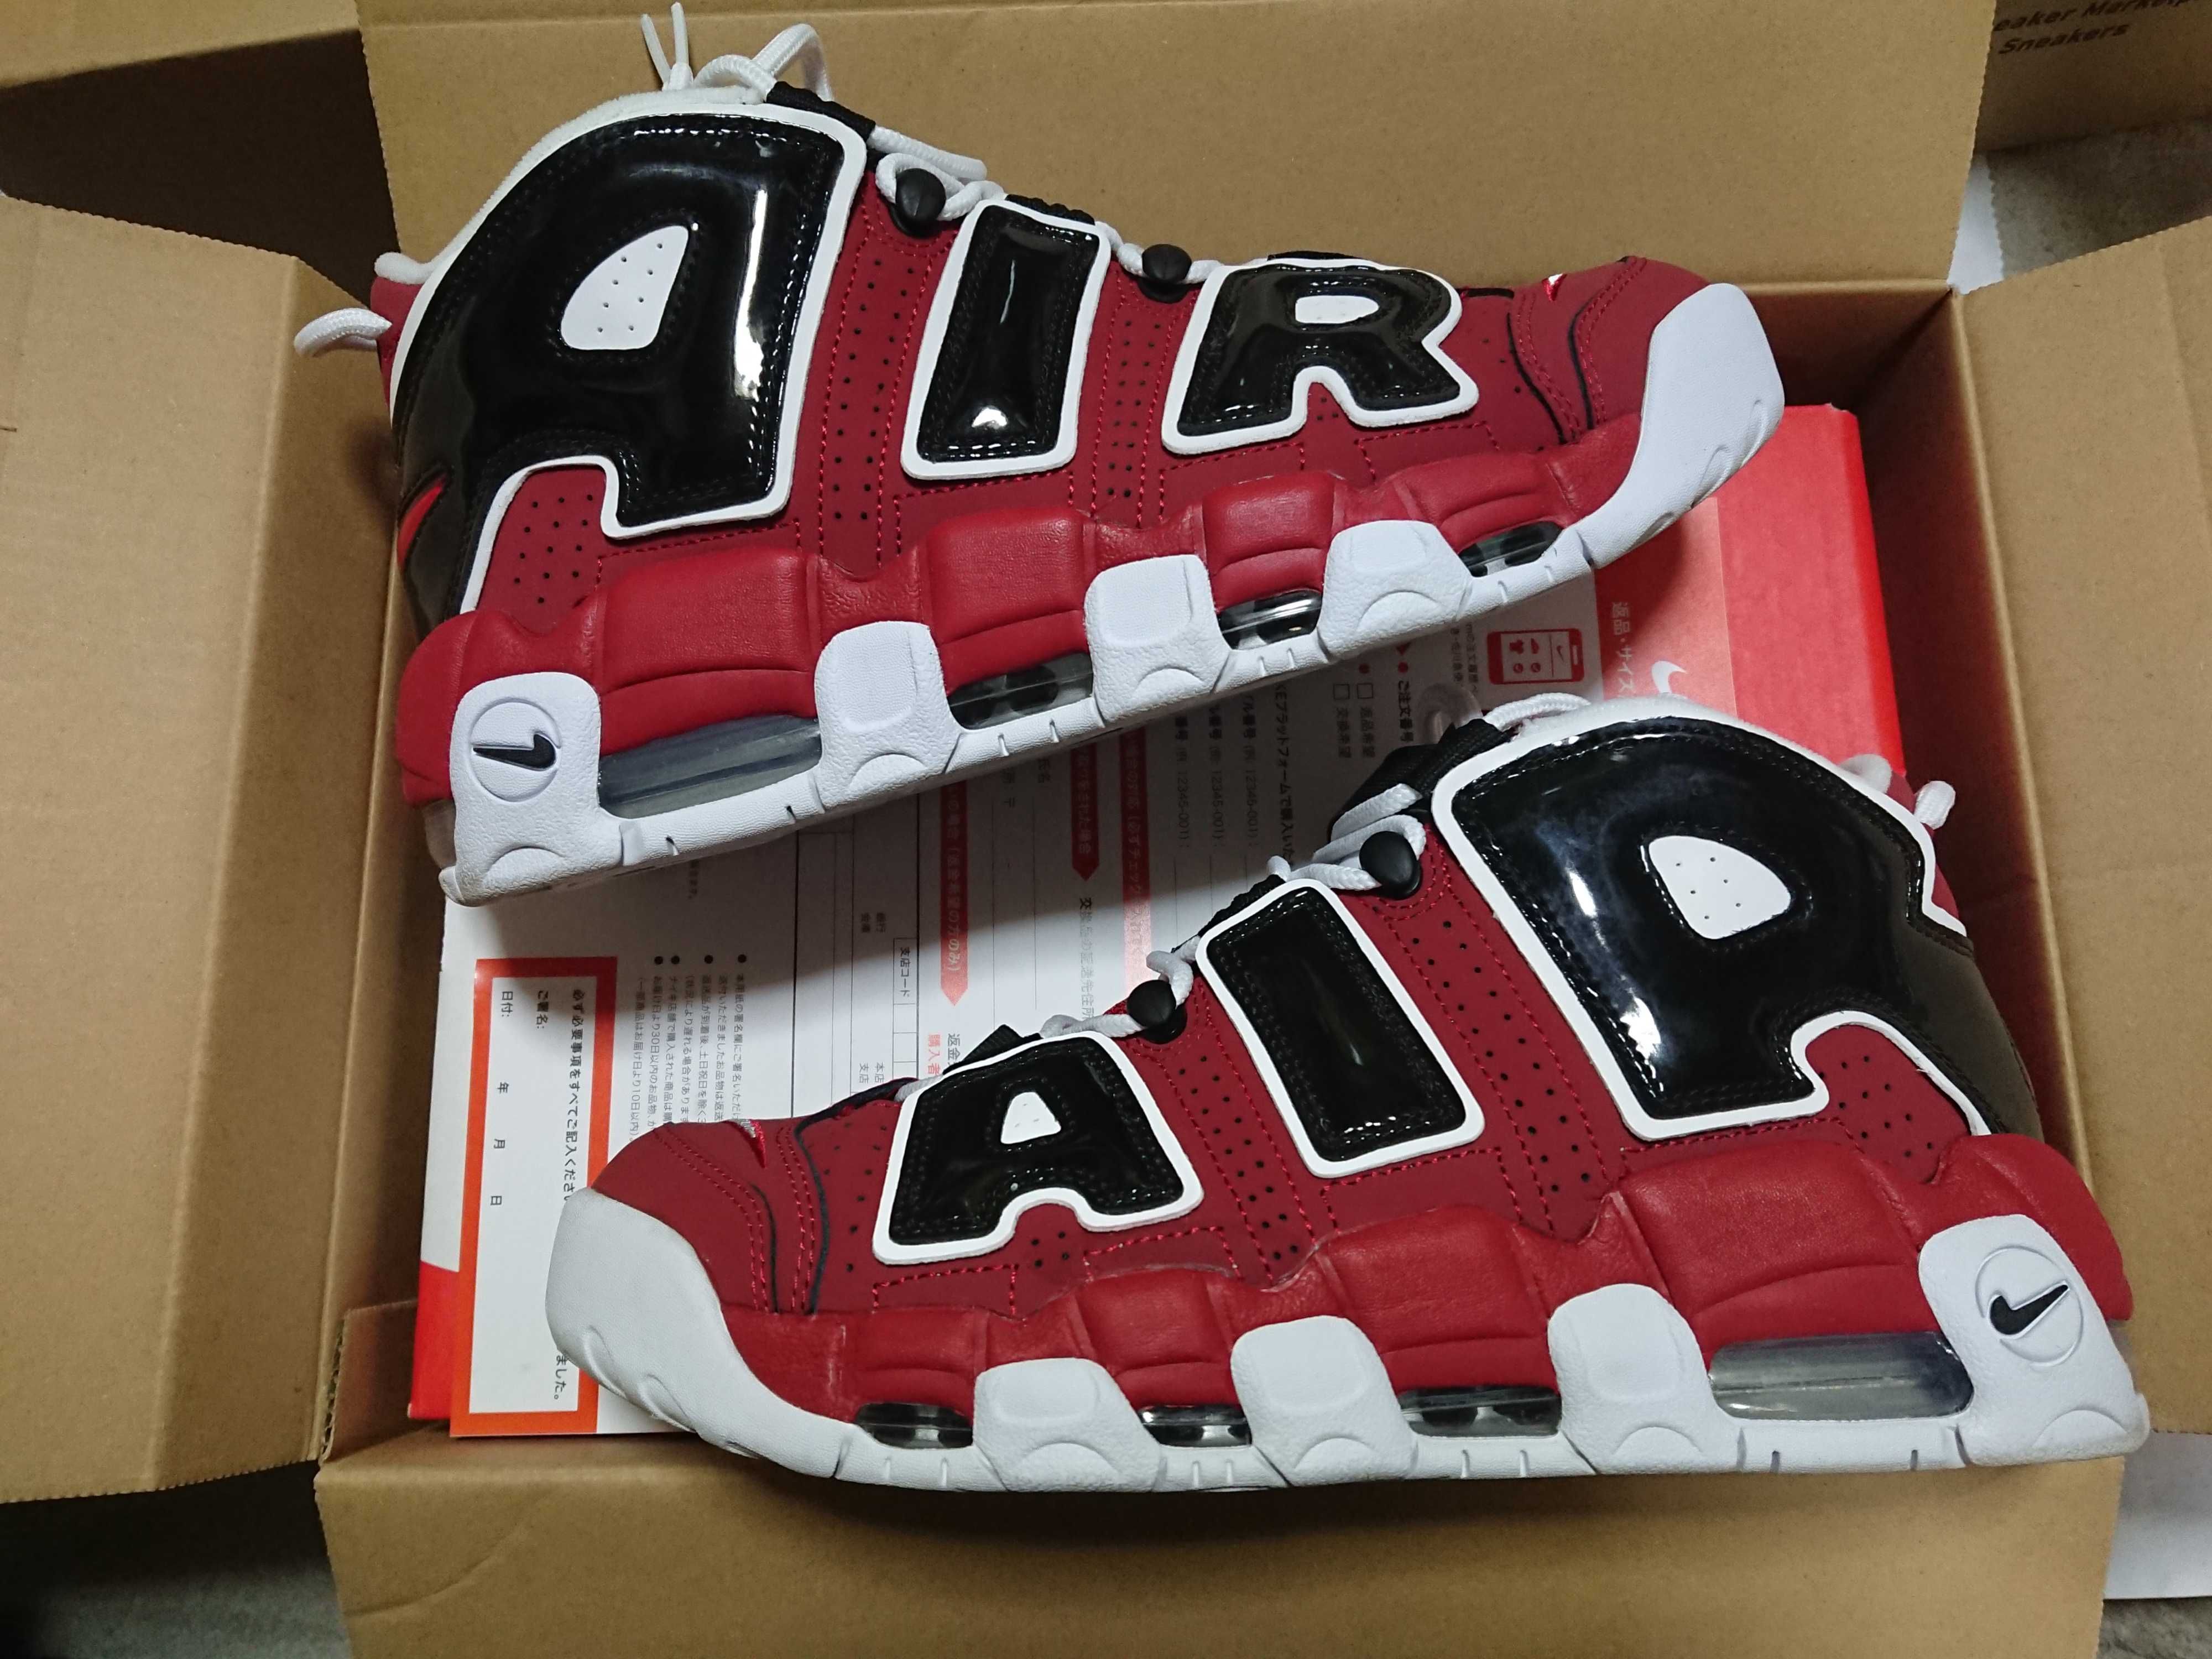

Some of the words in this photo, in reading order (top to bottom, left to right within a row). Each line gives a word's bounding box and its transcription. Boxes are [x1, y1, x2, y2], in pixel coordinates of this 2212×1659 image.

[1998, 24, 2130, 54] Sneakers
[1397, 680, 1414, 742] ご注文番号
[900, 947, 911, 997] 支店コード
[500, 991, 514, 1018] 日付:
[947, 1033, 961, 1066] 返金
[497, 1082, 509, 1093] 年
[494, 1138, 505, 1150] 月
[491, 1195, 502, 1206] 日
